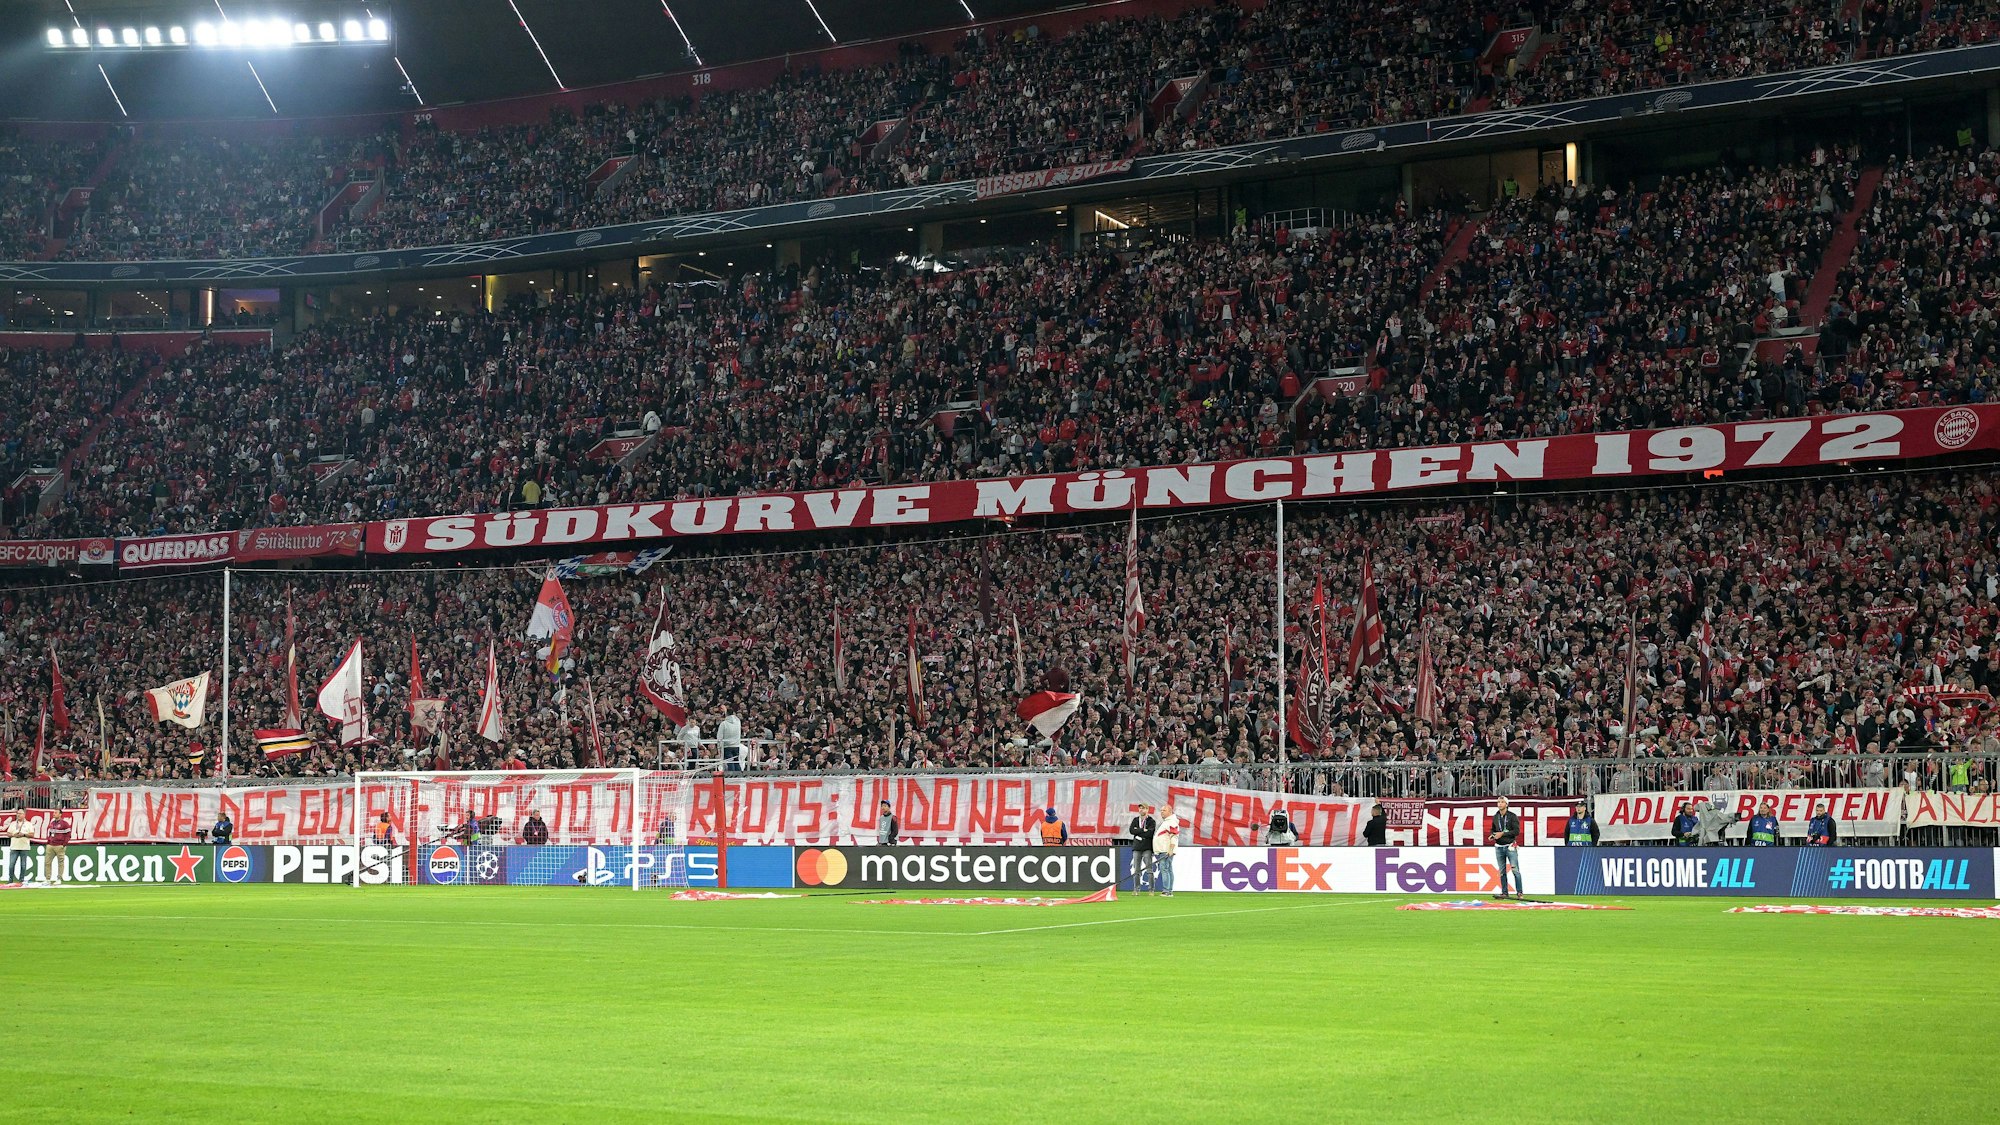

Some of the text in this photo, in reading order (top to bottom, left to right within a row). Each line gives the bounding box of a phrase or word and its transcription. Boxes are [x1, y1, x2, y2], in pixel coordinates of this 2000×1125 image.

[1511, 33, 1525, 43] 315
[692, 73, 711, 86] 318
[976, 158, 1134, 198] GIESSEN BULLS
[1950, 410, 1976, 424] BAYERN
[1938, 431, 1966, 446] MÜNCHEN
[424, 414, 1905, 552] SÜDKURVE MÜNCHEN 1972
[27, 543, 76, 561] ZÜRICH
[122, 536, 230, 564] QUEERPASS
[255, 531, 323, 550] Südkurve
[93, 792, 133, 838] ZU
[144, 793, 199, 839] VIEL
[218, 789, 288, 838] DES
[550, 784, 593, 834] TO
[968, 778, 1056, 834] NEW
[222, 860, 248, 868] PEPSI
[272, 845, 403, 885] PEPSI
[431, 860, 459, 870] PEPSI
[623, 853, 719, 880] PS5
[861, 847, 1116, 884] mastercard
[1201, 848, 1333, 892] FedEx
[1375, 848, 1516, 893] FedEx
[1601, 857, 1756, 888] WELCOME ALL
[1828, 858, 1971, 890] #FOOTBALL
